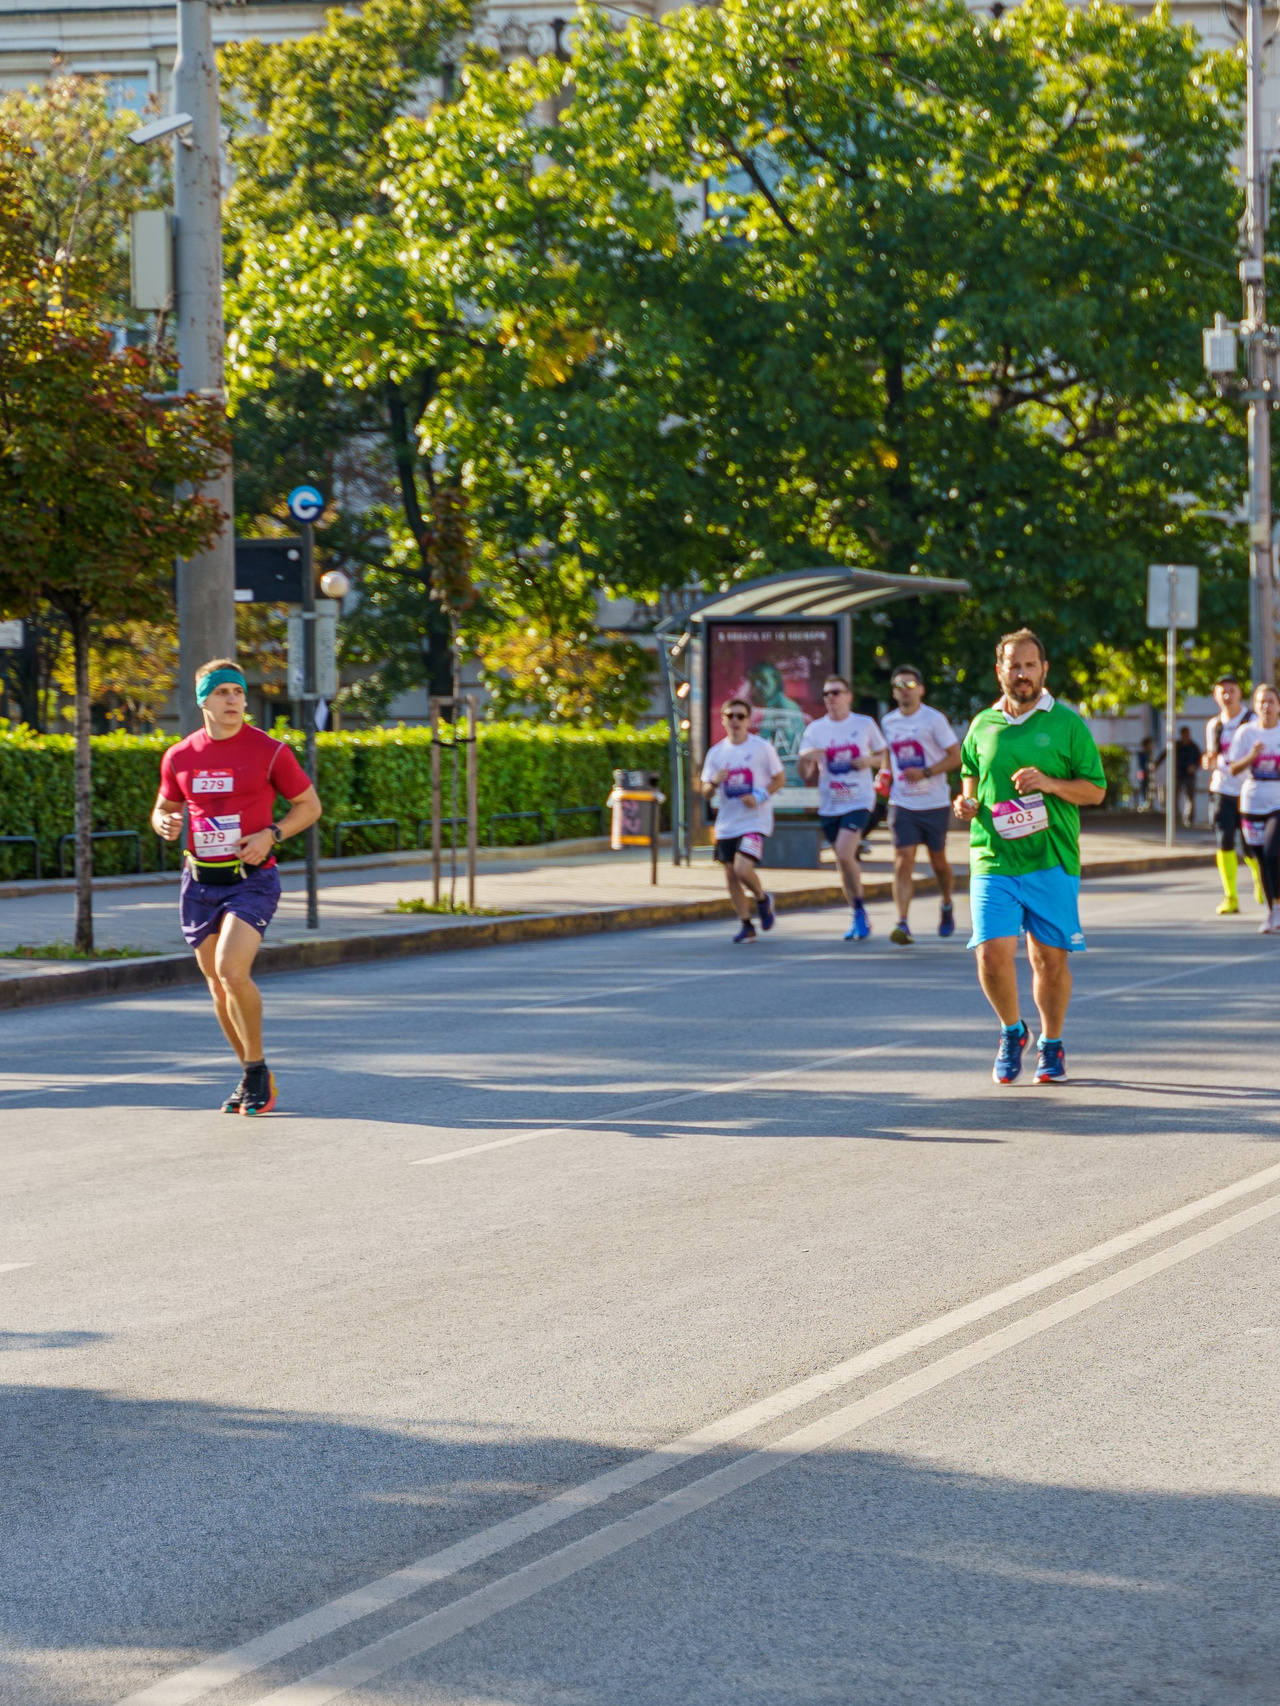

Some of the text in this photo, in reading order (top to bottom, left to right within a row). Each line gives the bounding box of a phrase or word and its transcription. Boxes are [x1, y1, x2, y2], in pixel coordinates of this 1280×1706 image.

[201, 780, 224, 790] 279
[1007, 811, 1033, 825] 403
[203, 832, 225, 844] 279
